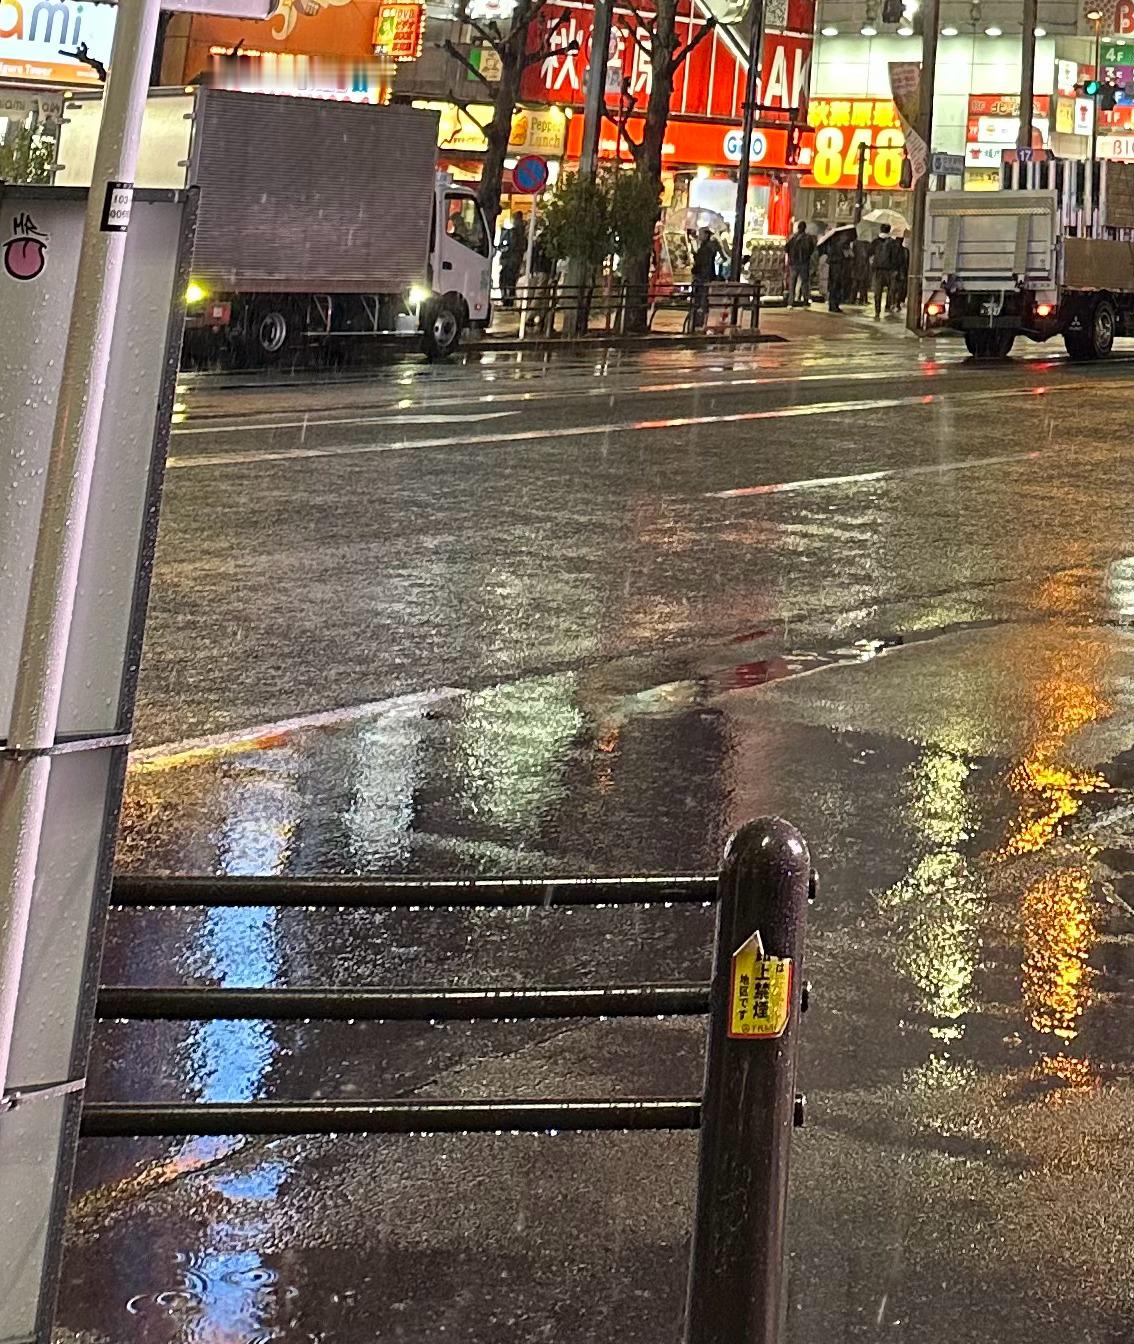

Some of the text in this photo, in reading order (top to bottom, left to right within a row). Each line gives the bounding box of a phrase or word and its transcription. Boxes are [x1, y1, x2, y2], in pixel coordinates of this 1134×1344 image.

[1105, 50, 1124, 63] 4F
[807, 100, 901, 128] 秋葉原最
[527, 133, 561, 148] Lunch
[726, 135, 763, 157] GO
[812, 126, 906, 188] 848
[1018, 150, 1032, 162] 17
